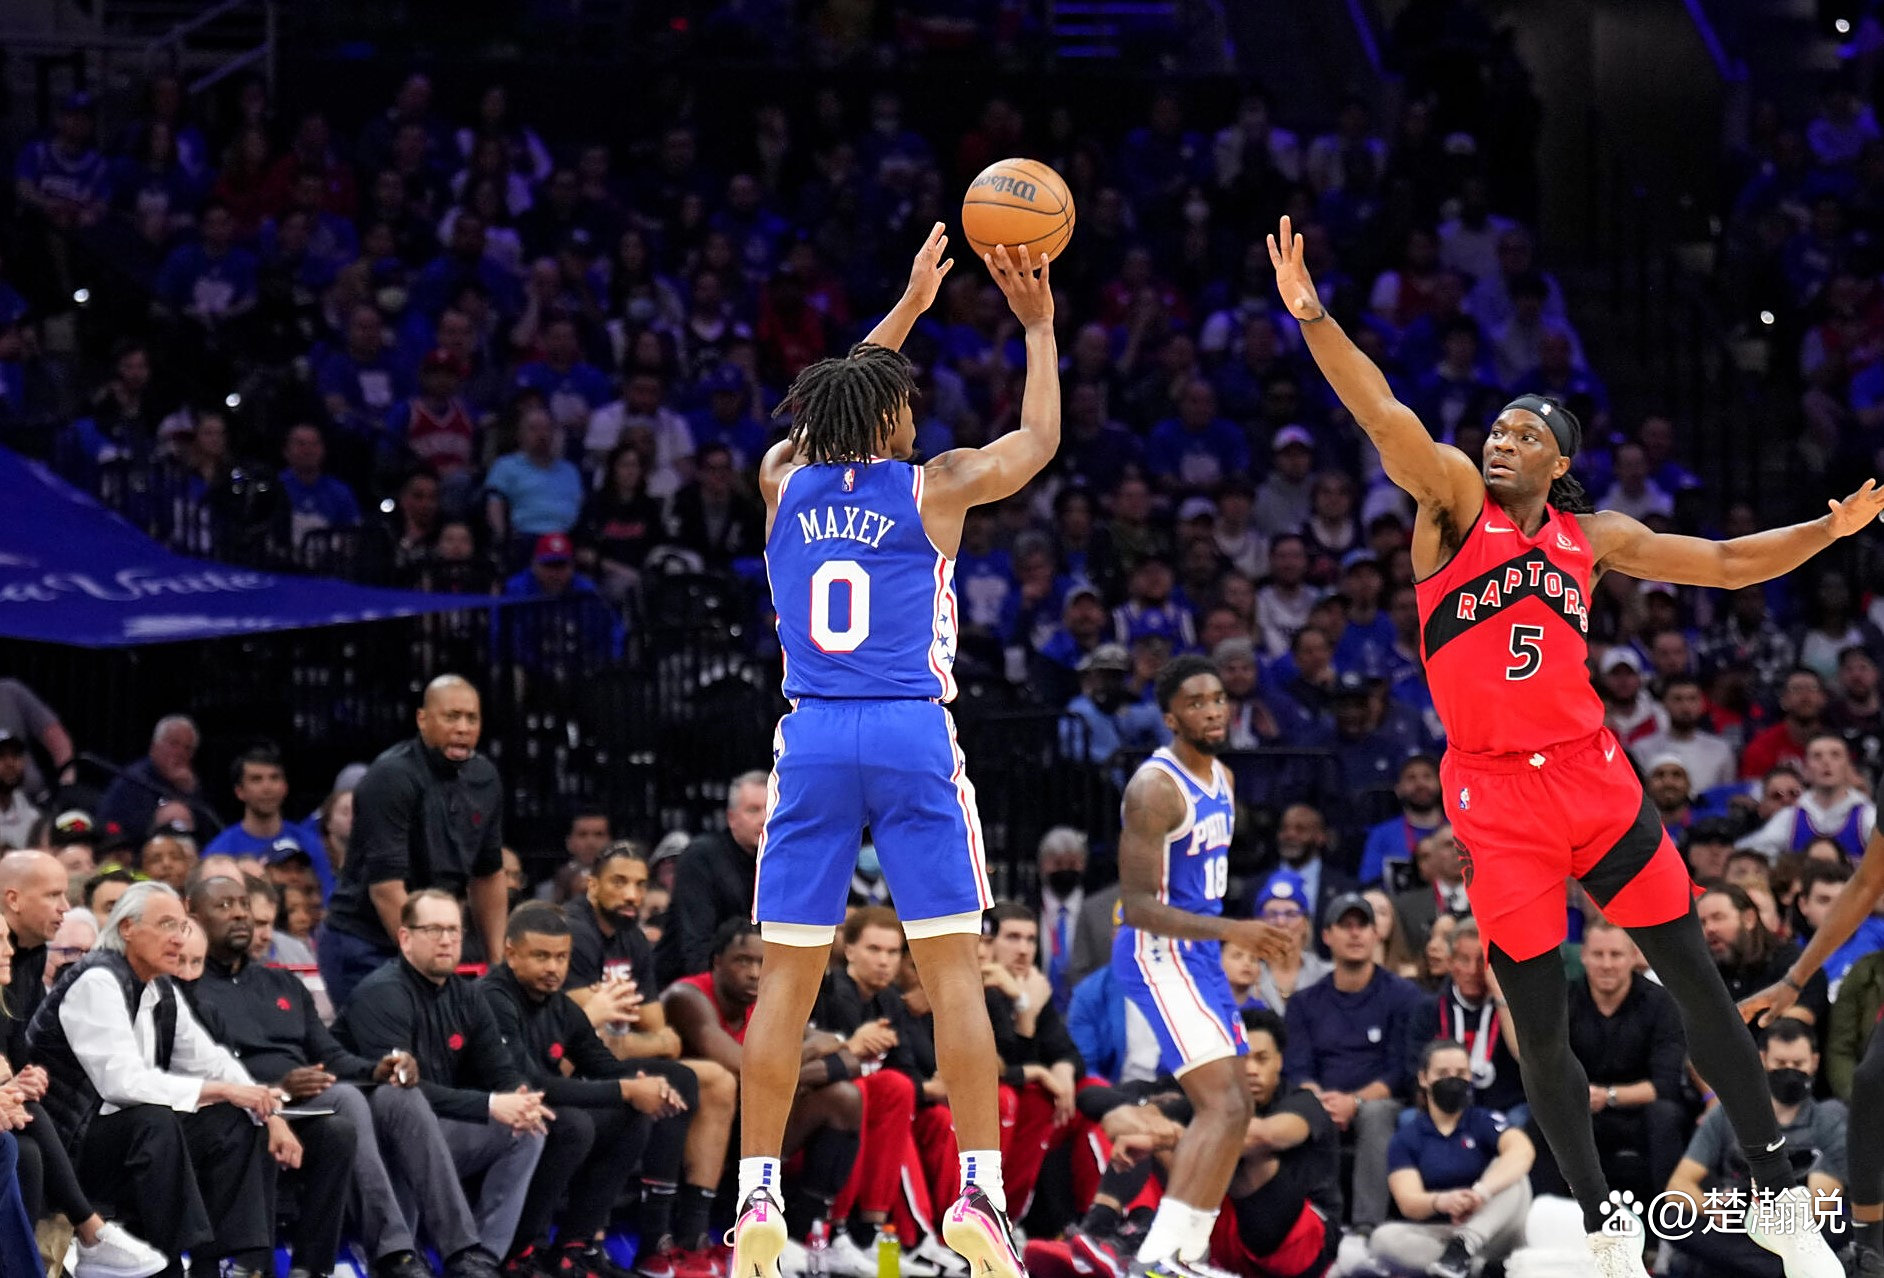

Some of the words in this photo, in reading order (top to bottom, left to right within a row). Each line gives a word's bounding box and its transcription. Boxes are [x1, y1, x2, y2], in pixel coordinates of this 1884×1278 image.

[797, 506, 896, 549] MAXEY
[809, 560, 870, 654] 0
[1456, 561, 1589, 633] RAPTORS
[1505, 623, 1544, 681] 5
[1204, 856, 1229, 901] 18
